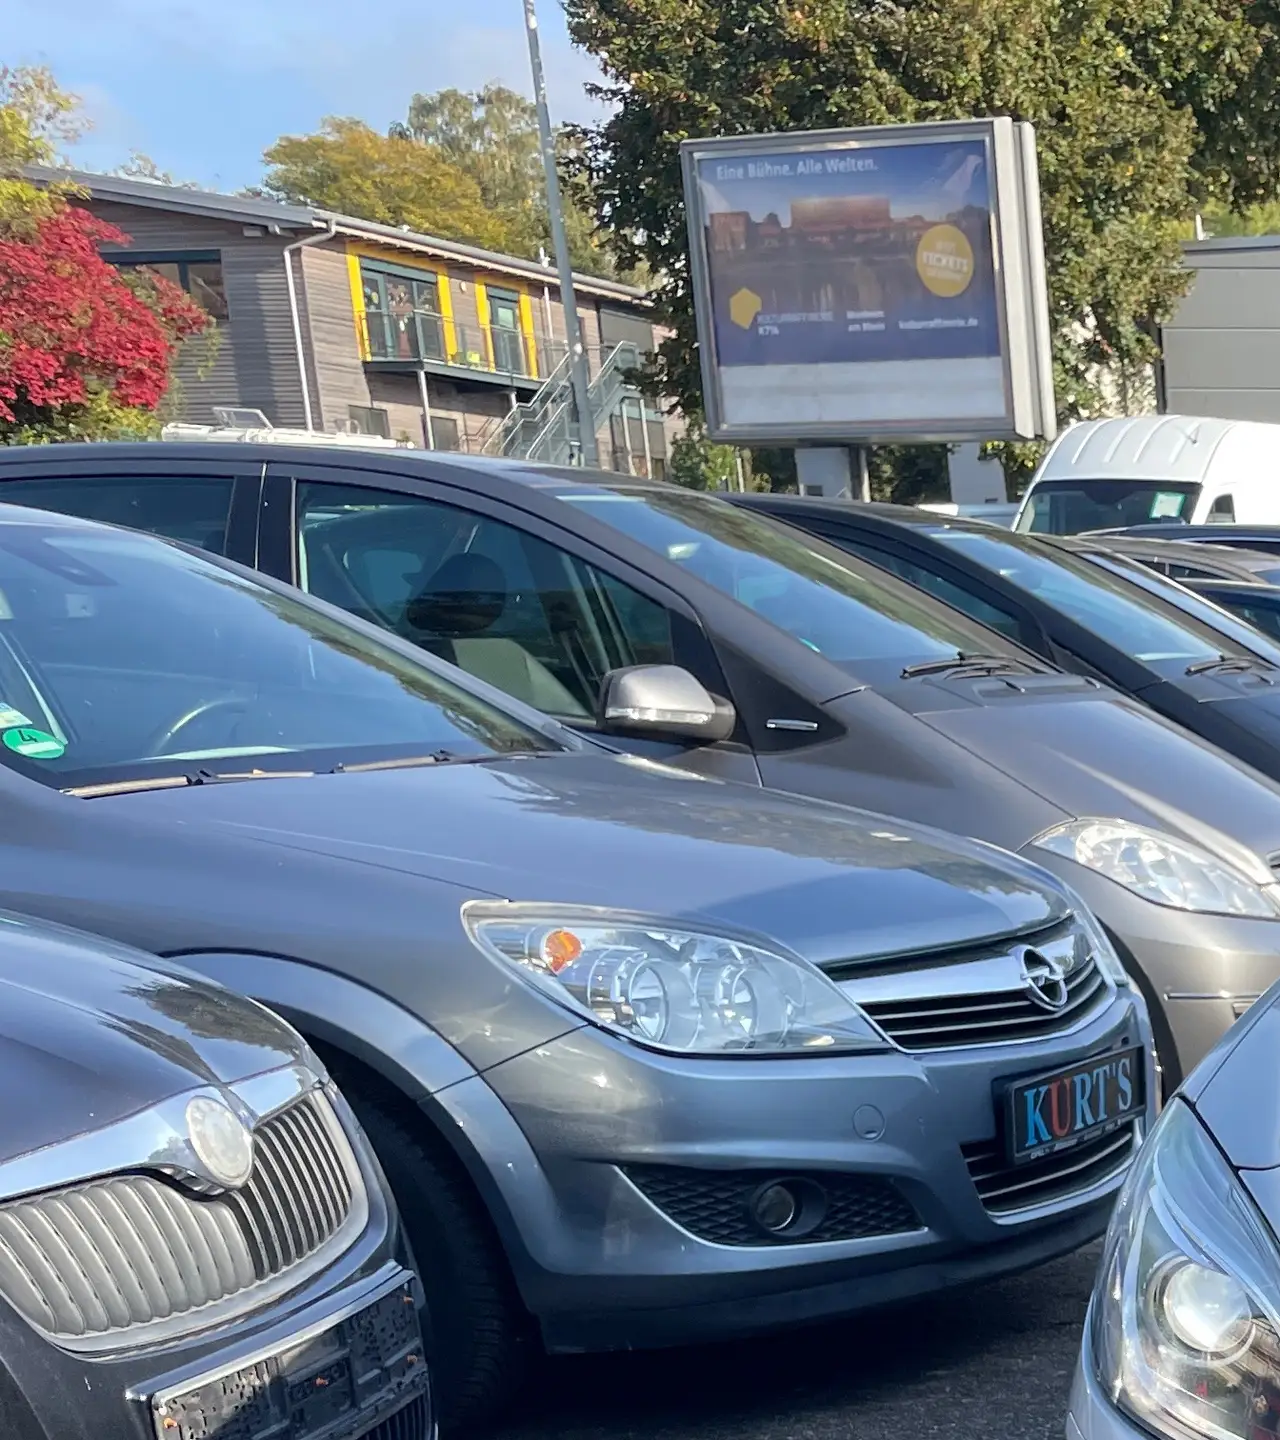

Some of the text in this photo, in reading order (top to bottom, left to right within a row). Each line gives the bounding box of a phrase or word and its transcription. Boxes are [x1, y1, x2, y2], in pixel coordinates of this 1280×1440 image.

[716, 157, 878, 180] Eine Bühne. Alle Welten.
[17, 729, 38, 743] 4
[1024, 1058, 1132, 1147] KURT'S
